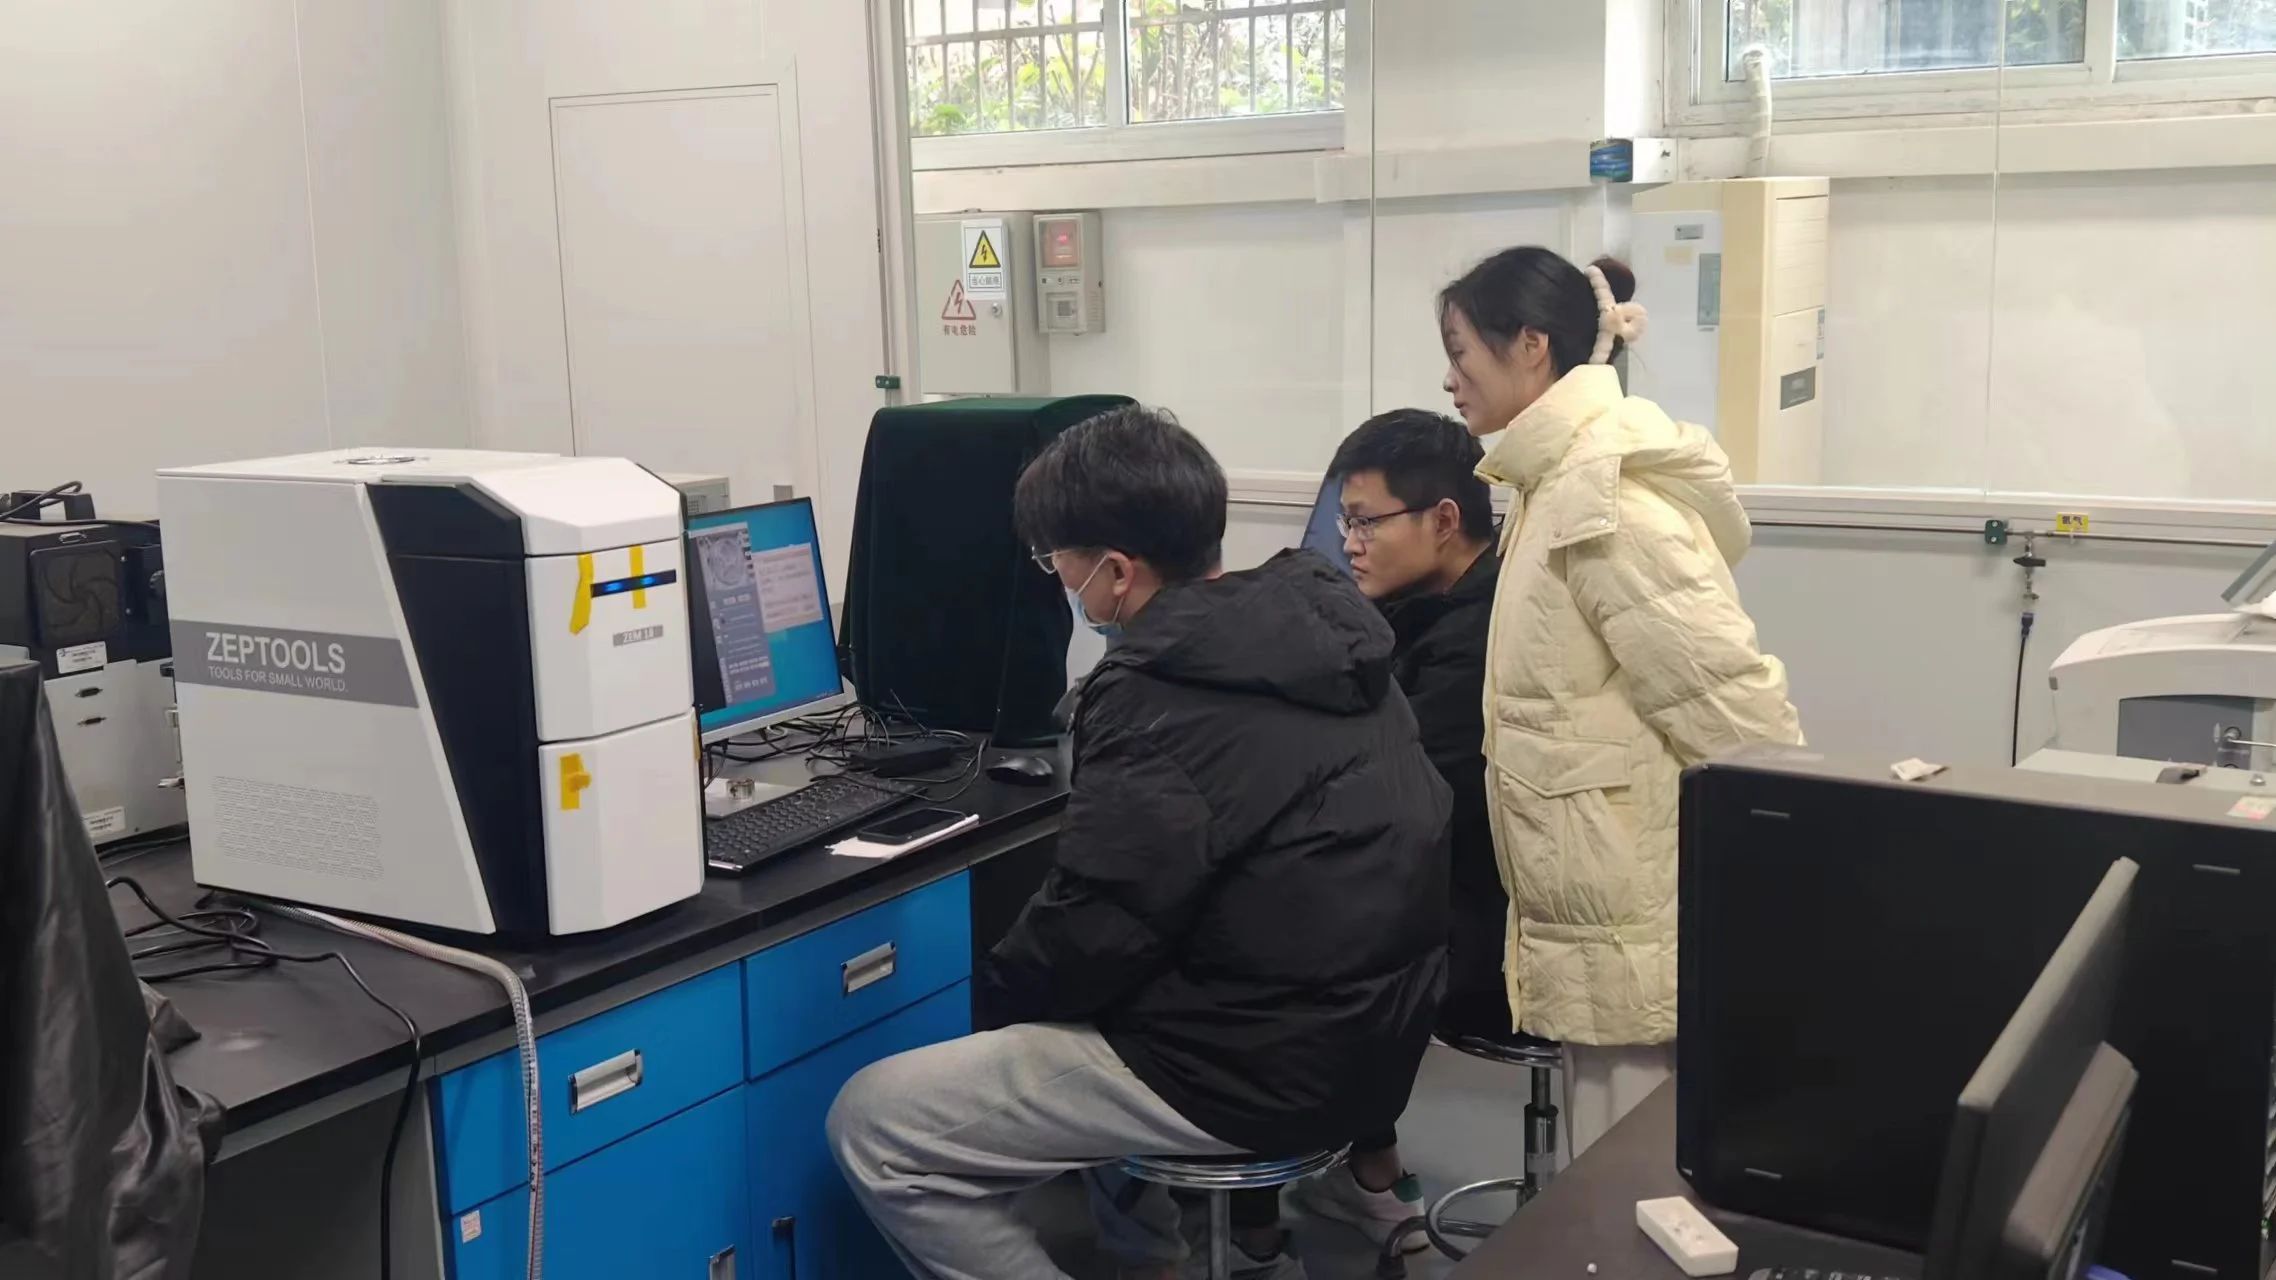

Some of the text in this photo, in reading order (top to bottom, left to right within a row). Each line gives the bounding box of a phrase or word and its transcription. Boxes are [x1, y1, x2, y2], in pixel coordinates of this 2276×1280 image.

[622, 630, 641, 643] ZEM
[206, 632, 346, 674] ZEPTOOLS
[208, 665, 243, 681] TOOLS
[245, 670, 267, 683] FOR
[268, 672, 303, 688] SMALL
